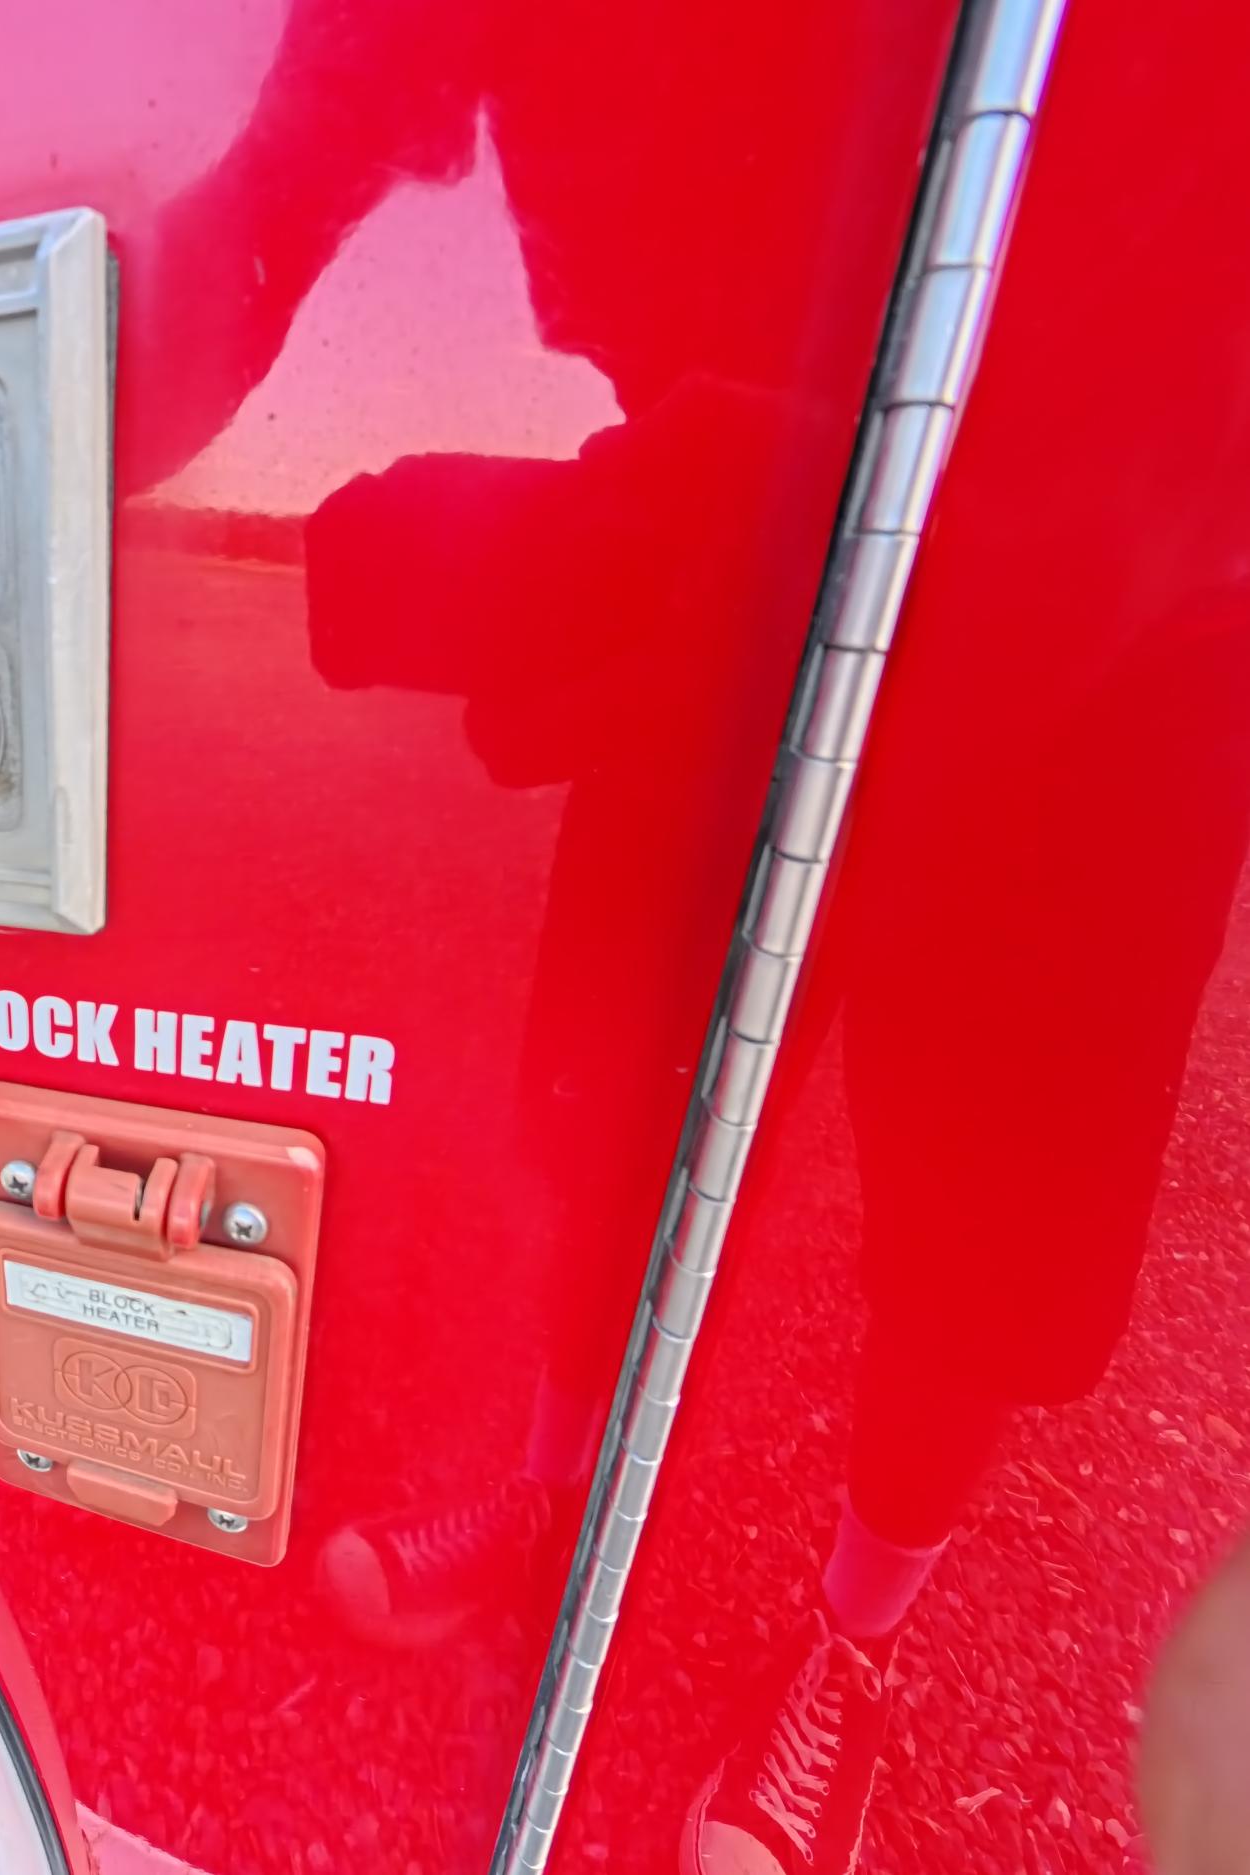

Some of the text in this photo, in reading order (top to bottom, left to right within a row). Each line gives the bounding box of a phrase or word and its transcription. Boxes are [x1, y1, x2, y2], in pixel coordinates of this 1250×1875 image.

[134, 1008, 396, 1105] HEATER
[82, 1304, 159, 1332] HEATER
[89, 1289, 155, 1316] BLOCK
[10, 1397, 247, 1480] KUSSMAUL
[13, 1415, 141, 1461] ELECTRONICS
